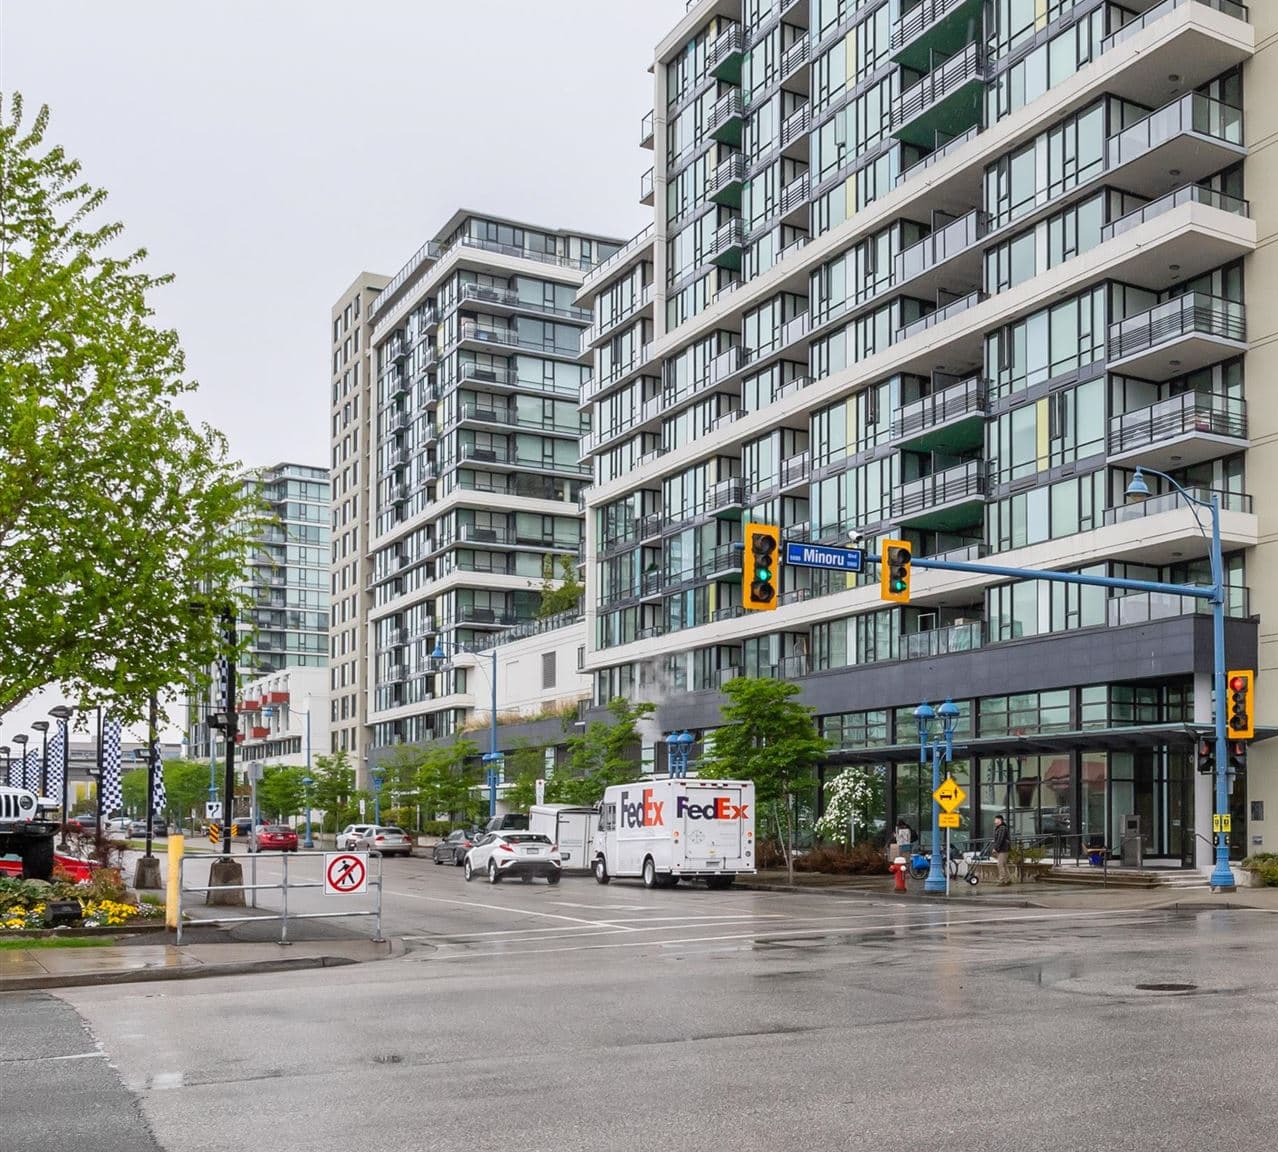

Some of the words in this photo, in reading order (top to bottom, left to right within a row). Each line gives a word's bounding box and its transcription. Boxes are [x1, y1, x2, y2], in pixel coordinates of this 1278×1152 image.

[803, 549, 845, 566] Minoru
[621, 788, 664, 828] FedEx
[676, 796, 749, 820] FedEx
